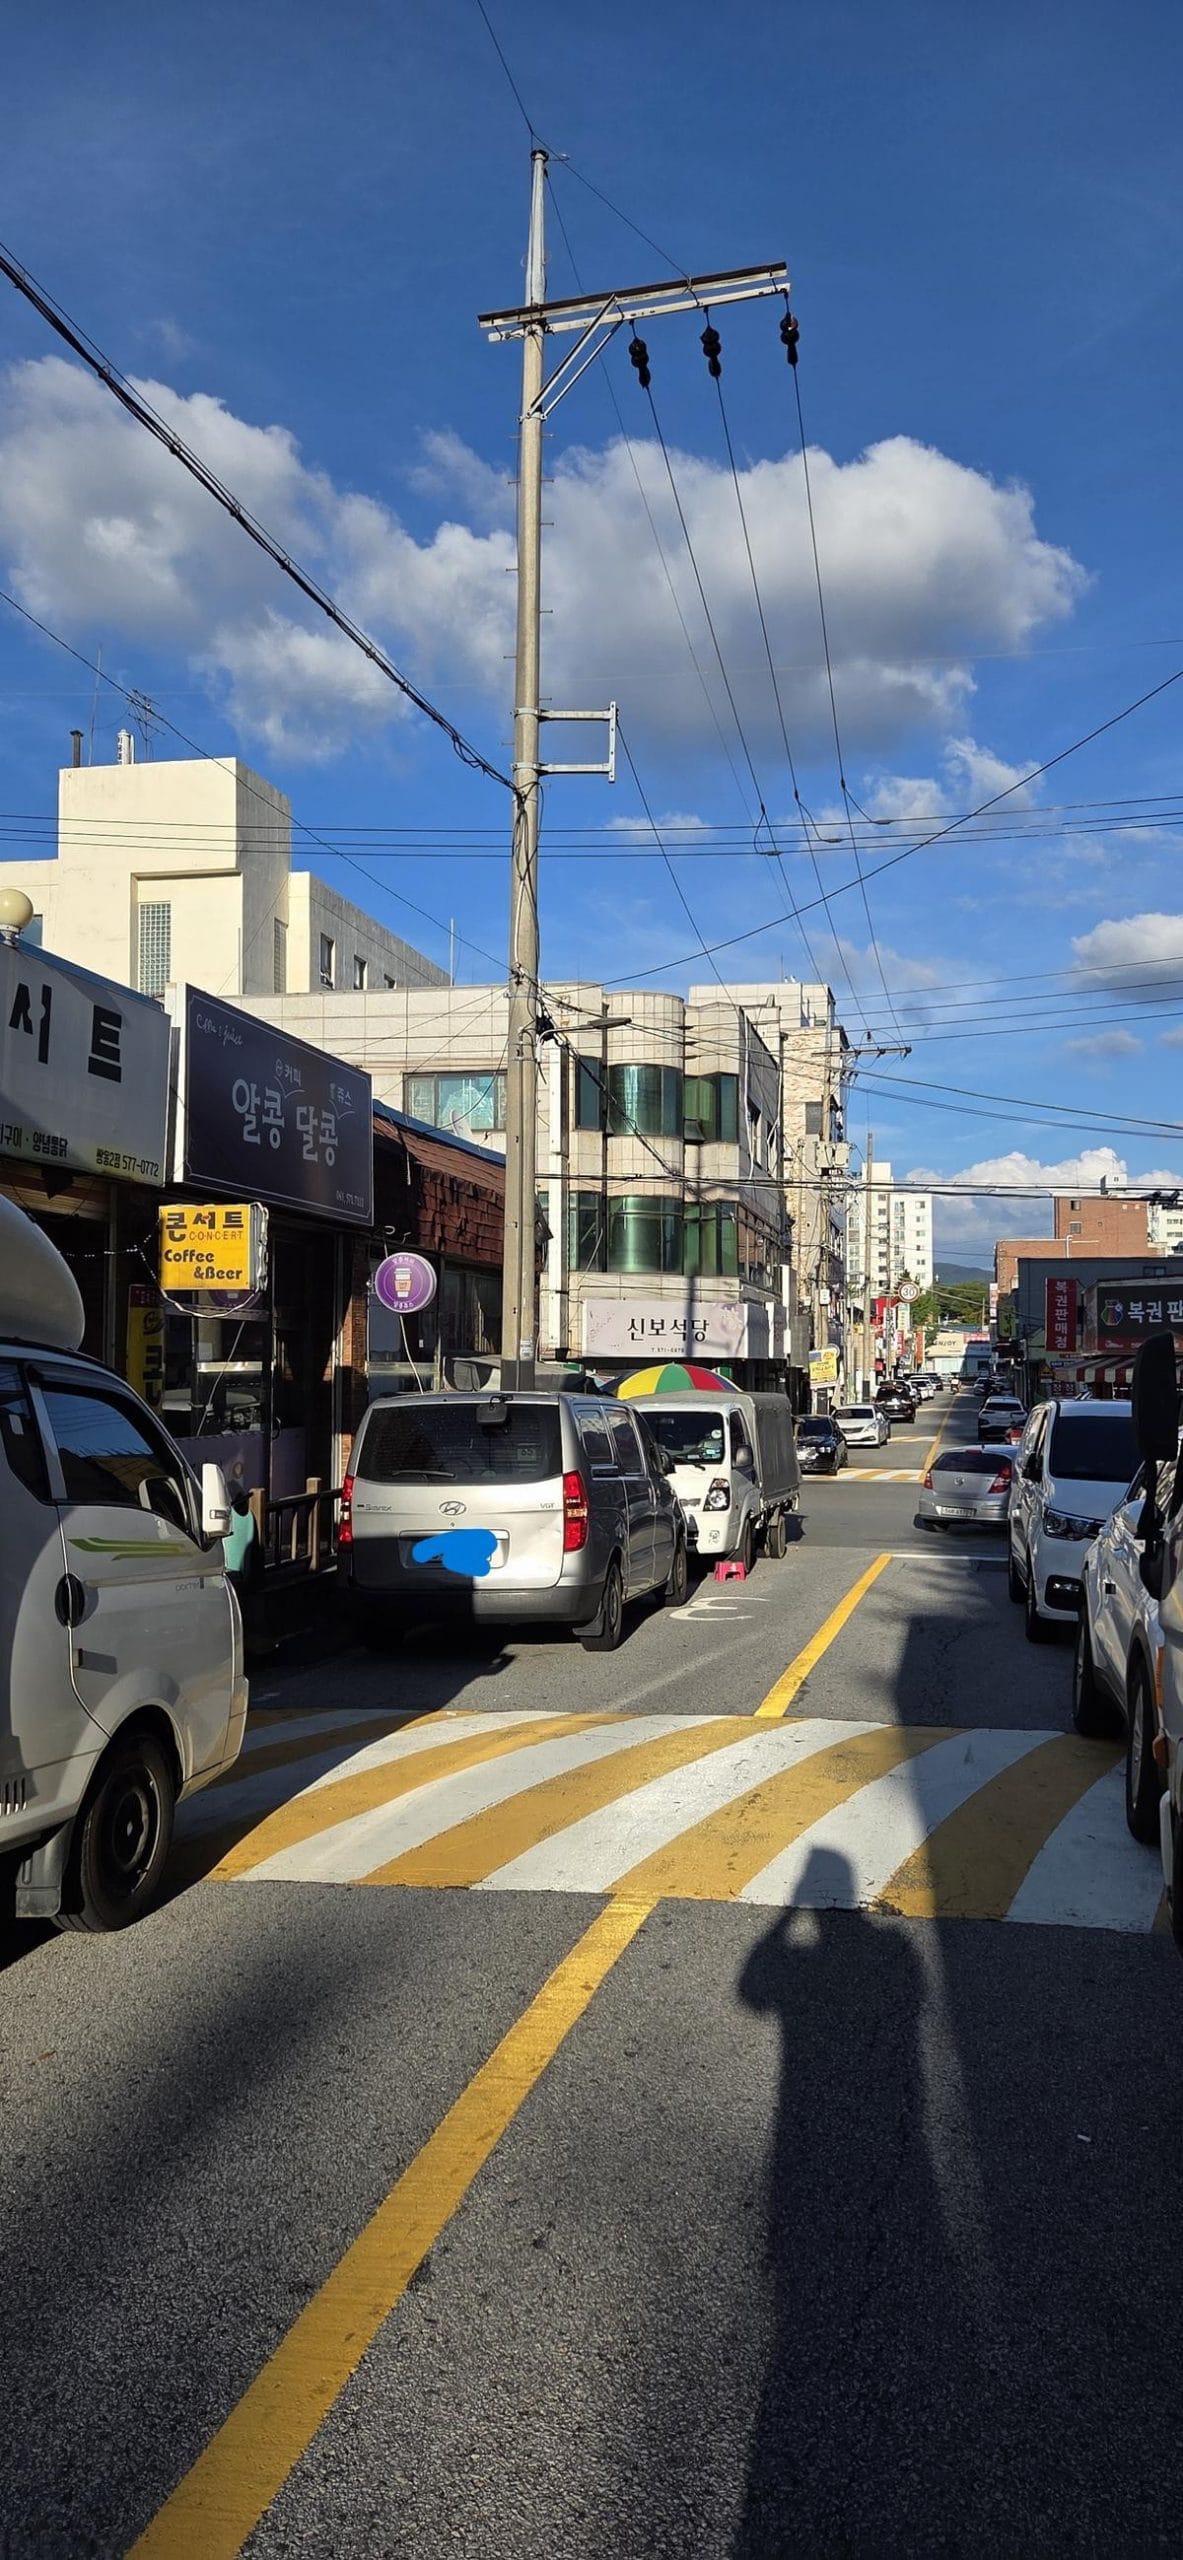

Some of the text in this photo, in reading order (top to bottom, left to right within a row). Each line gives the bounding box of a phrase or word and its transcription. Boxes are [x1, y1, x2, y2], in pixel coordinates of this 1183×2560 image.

[285, 1068, 301, 1087] 커피
[232, 1078, 339, 1167] 알콩 달콩
[33, 1131, 68, 1158] 양념통닭
[122, 1154, 159, 1178] 577-0772
[166, 1211, 244, 1242] 콘서트
[163, 1248, 215, 1263] Coffee
[193, 1265, 243, 1280] &Beer
[902, 1287, 915, 1297] 30
[1054, 1280, 1069, 1349] 복권판매점
[1127, 1299, 1183, 1324] 복권 판
[627, 1317, 710, 1343] 신보석당
